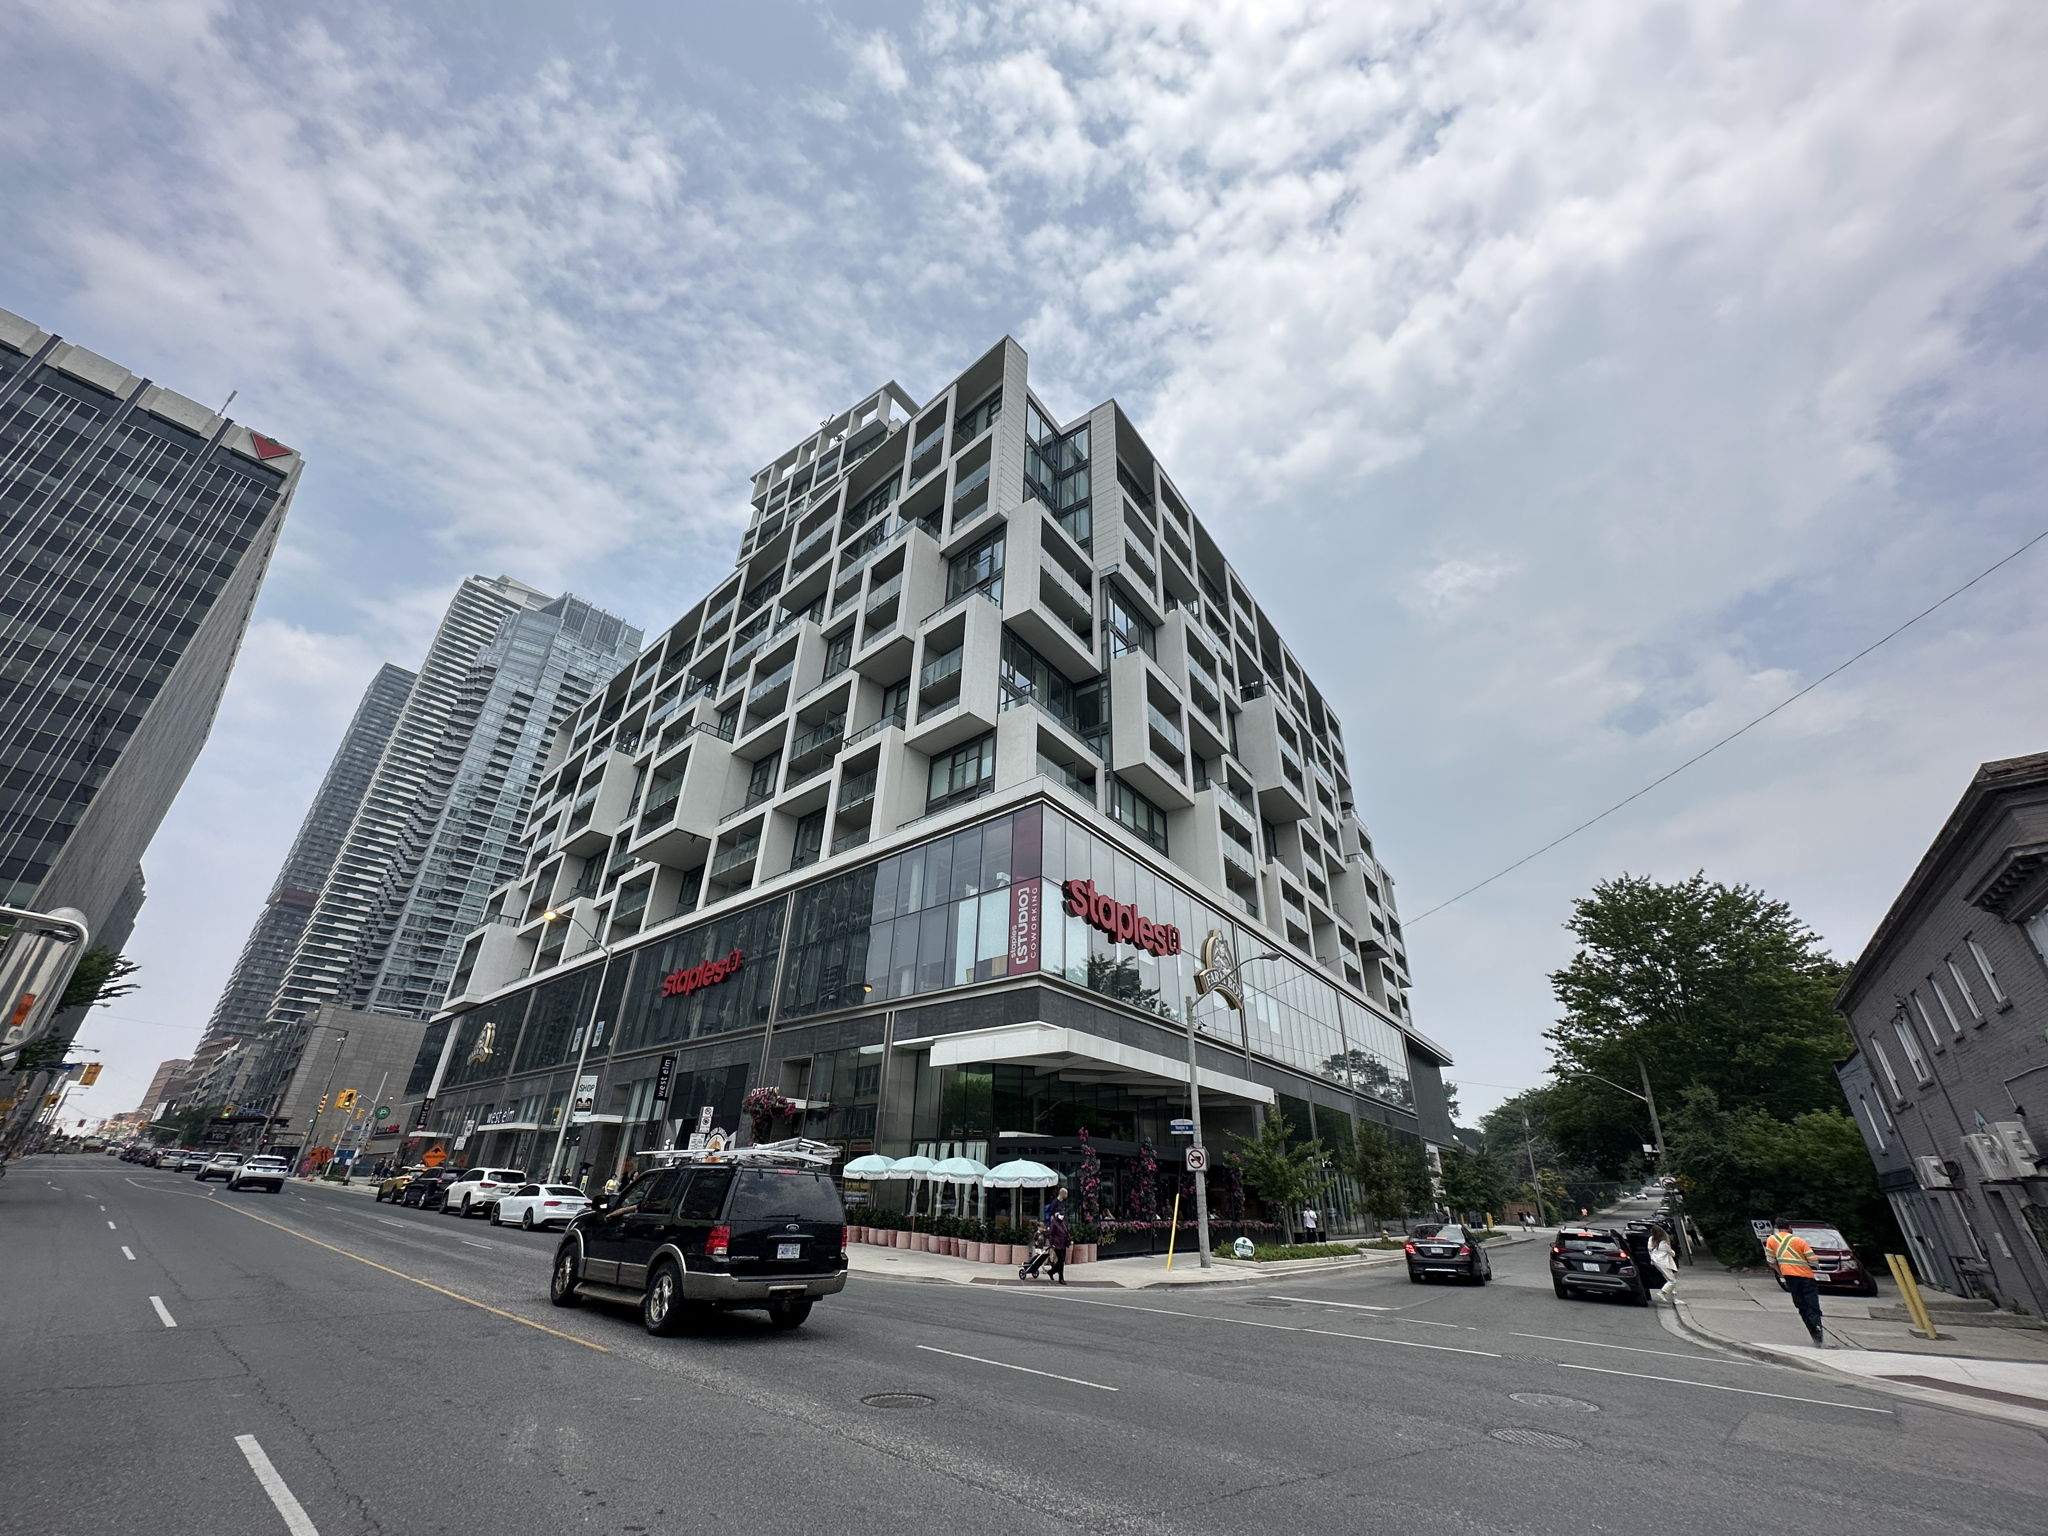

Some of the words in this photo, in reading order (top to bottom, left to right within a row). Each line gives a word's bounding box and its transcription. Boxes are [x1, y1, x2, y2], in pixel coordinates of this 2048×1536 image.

[1030, 887, 1038, 959] COWORKING
[1064, 879, 1168, 957] staples
[661, 957, 726, 998] staples
[662, 1059, 672, 1075] elm
[578, 1084, 596, 1093] SHOP
[657, 1076, 668, 1098] west
[486, 1110, 503, 1124] west
[502, 1107, 515, 1122] elm
